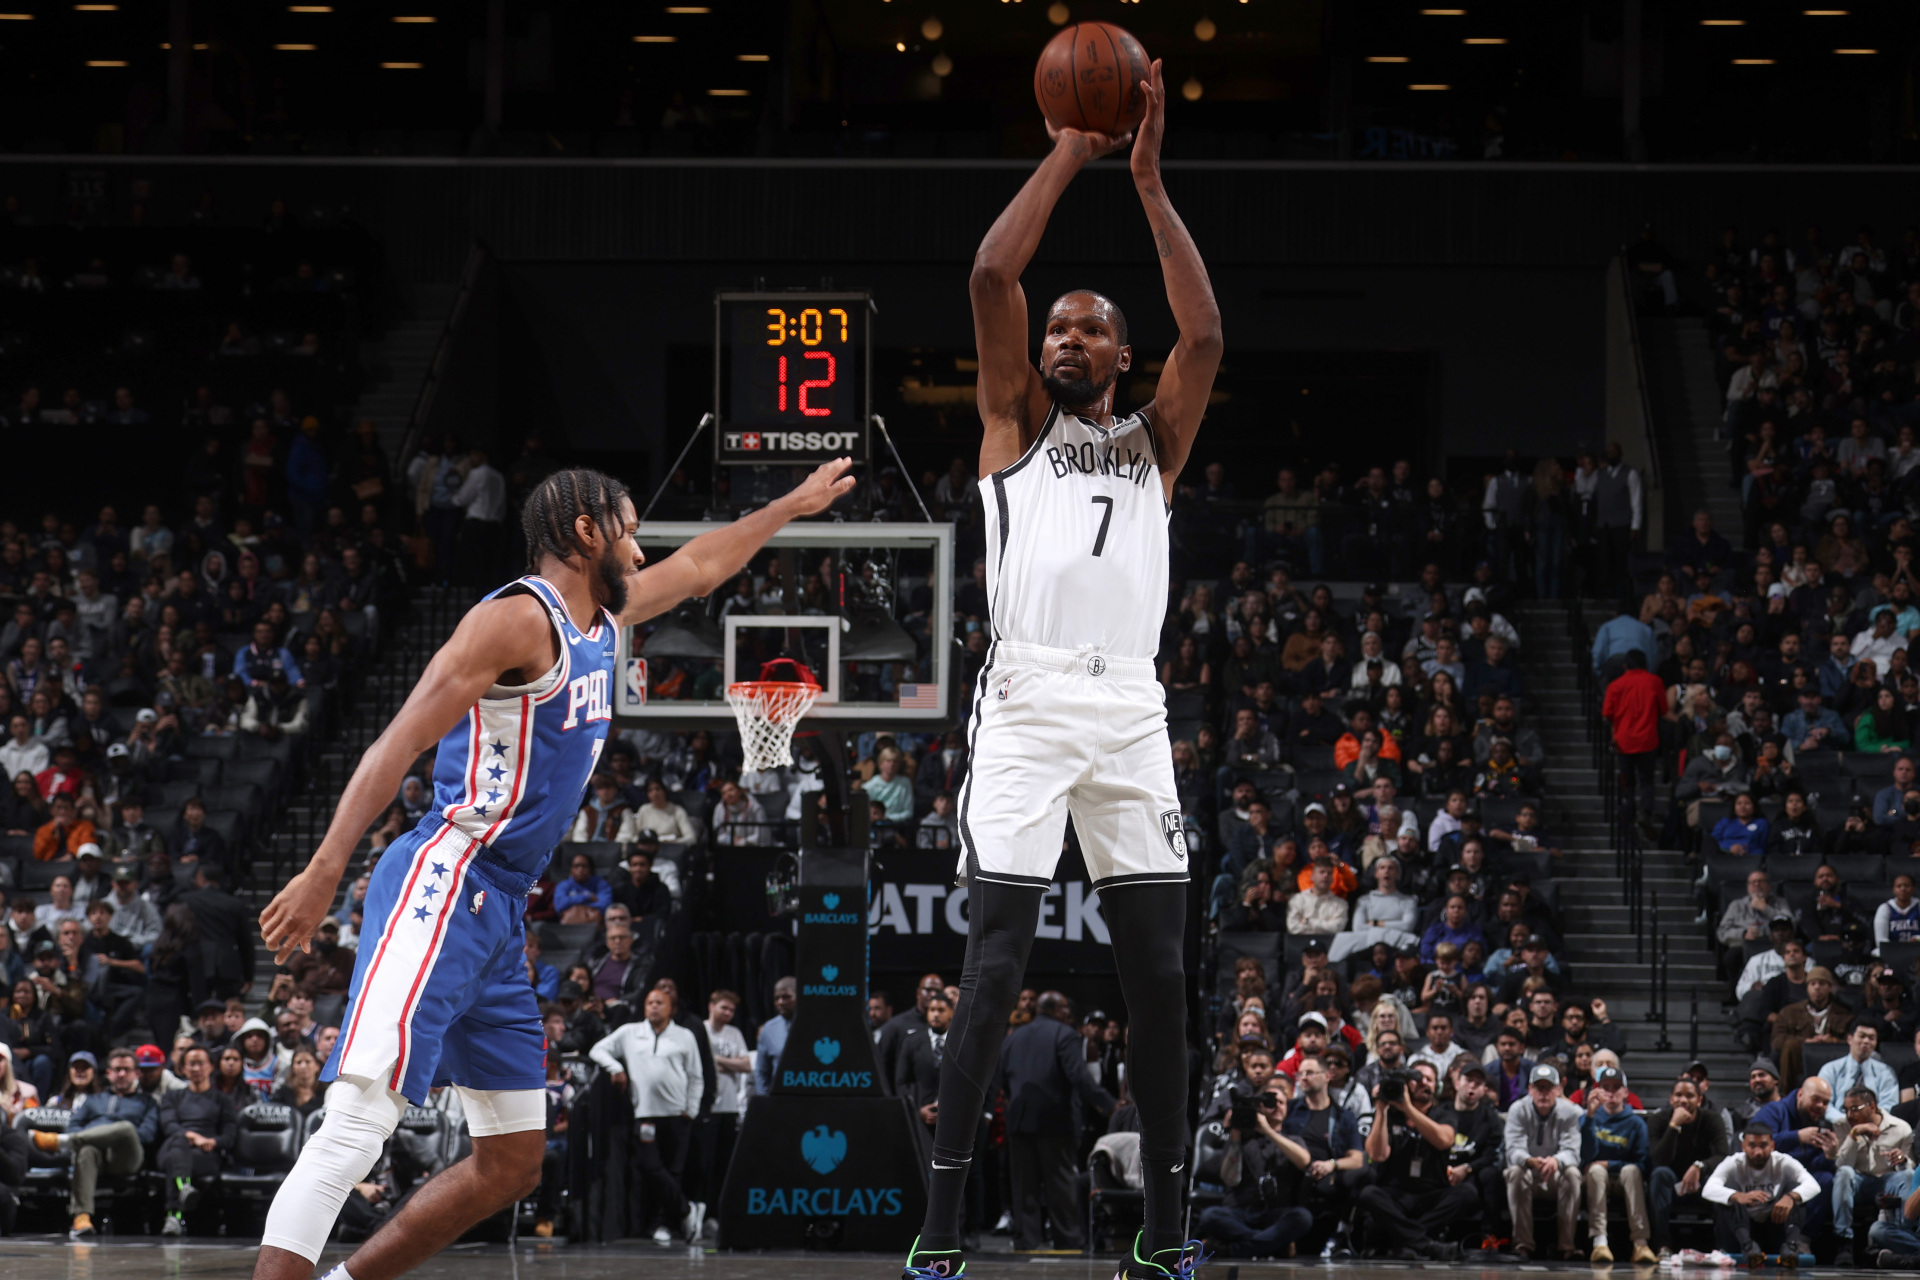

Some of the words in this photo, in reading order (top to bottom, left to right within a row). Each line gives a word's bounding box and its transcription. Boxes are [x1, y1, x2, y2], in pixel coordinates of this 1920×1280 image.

[767, 308, 848, 346] 3:07
[778, 351, 836, 416] 12
[762, 432, 859, 450] TISSOT
[1091, 495, 1113, 557] 7
[1164, 812, 1184, 833] NE
[804, 912, 859, 925] BARCLAYS
[803, 984, 858, 996] BARCLAYS
[782, 1070, 872, 1088] BARCLAYS
[404, 1107, 439, 1120] ATAR
[746, 1187, 903, 1216] BARCLAYS
